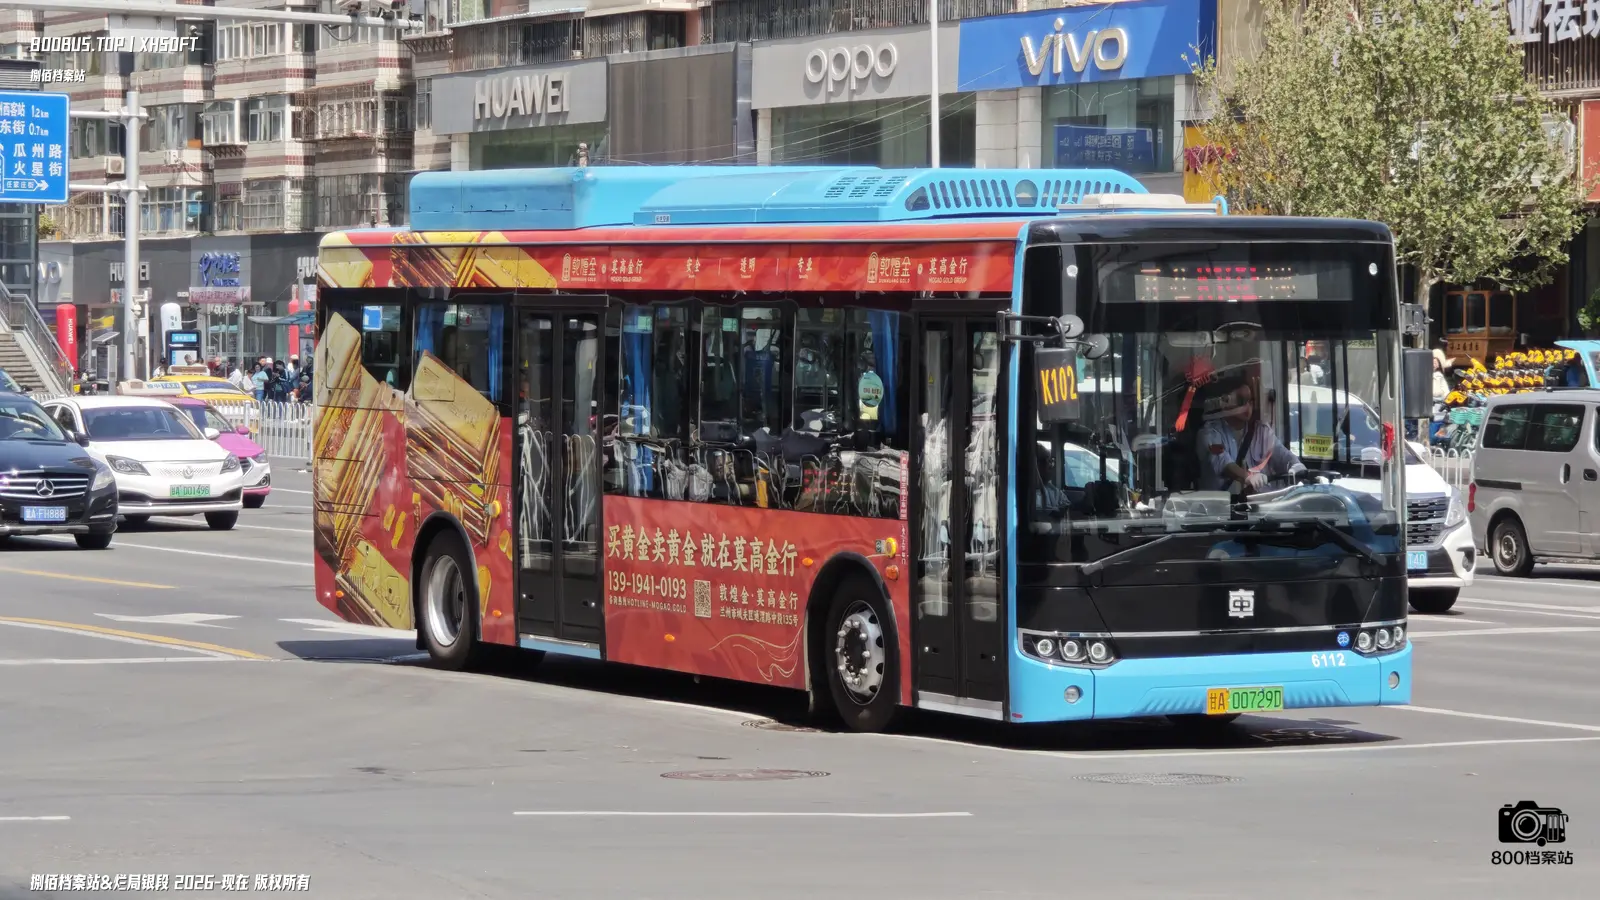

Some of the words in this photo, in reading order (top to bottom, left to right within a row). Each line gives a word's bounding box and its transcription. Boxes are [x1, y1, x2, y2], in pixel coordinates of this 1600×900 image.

[1020, 17, 1128, 76] vivo
[805, 42, 898, 92] oppo
[474, 72, 571, 120] HUAWEI
[0, 102, 25, 117] 西客站
[13, 143, 62, 158] 瓜州路
[13, 161, 62, 176] 火星街
[110, 262, 149, 281] HUEI
[929, 257, 968, 275] 莫高金行
[1040, 365, 1078, 405] K102
[608, 570, 687, 599] 139-1941-0193
[1311, 653, 1346, 668] 6112
